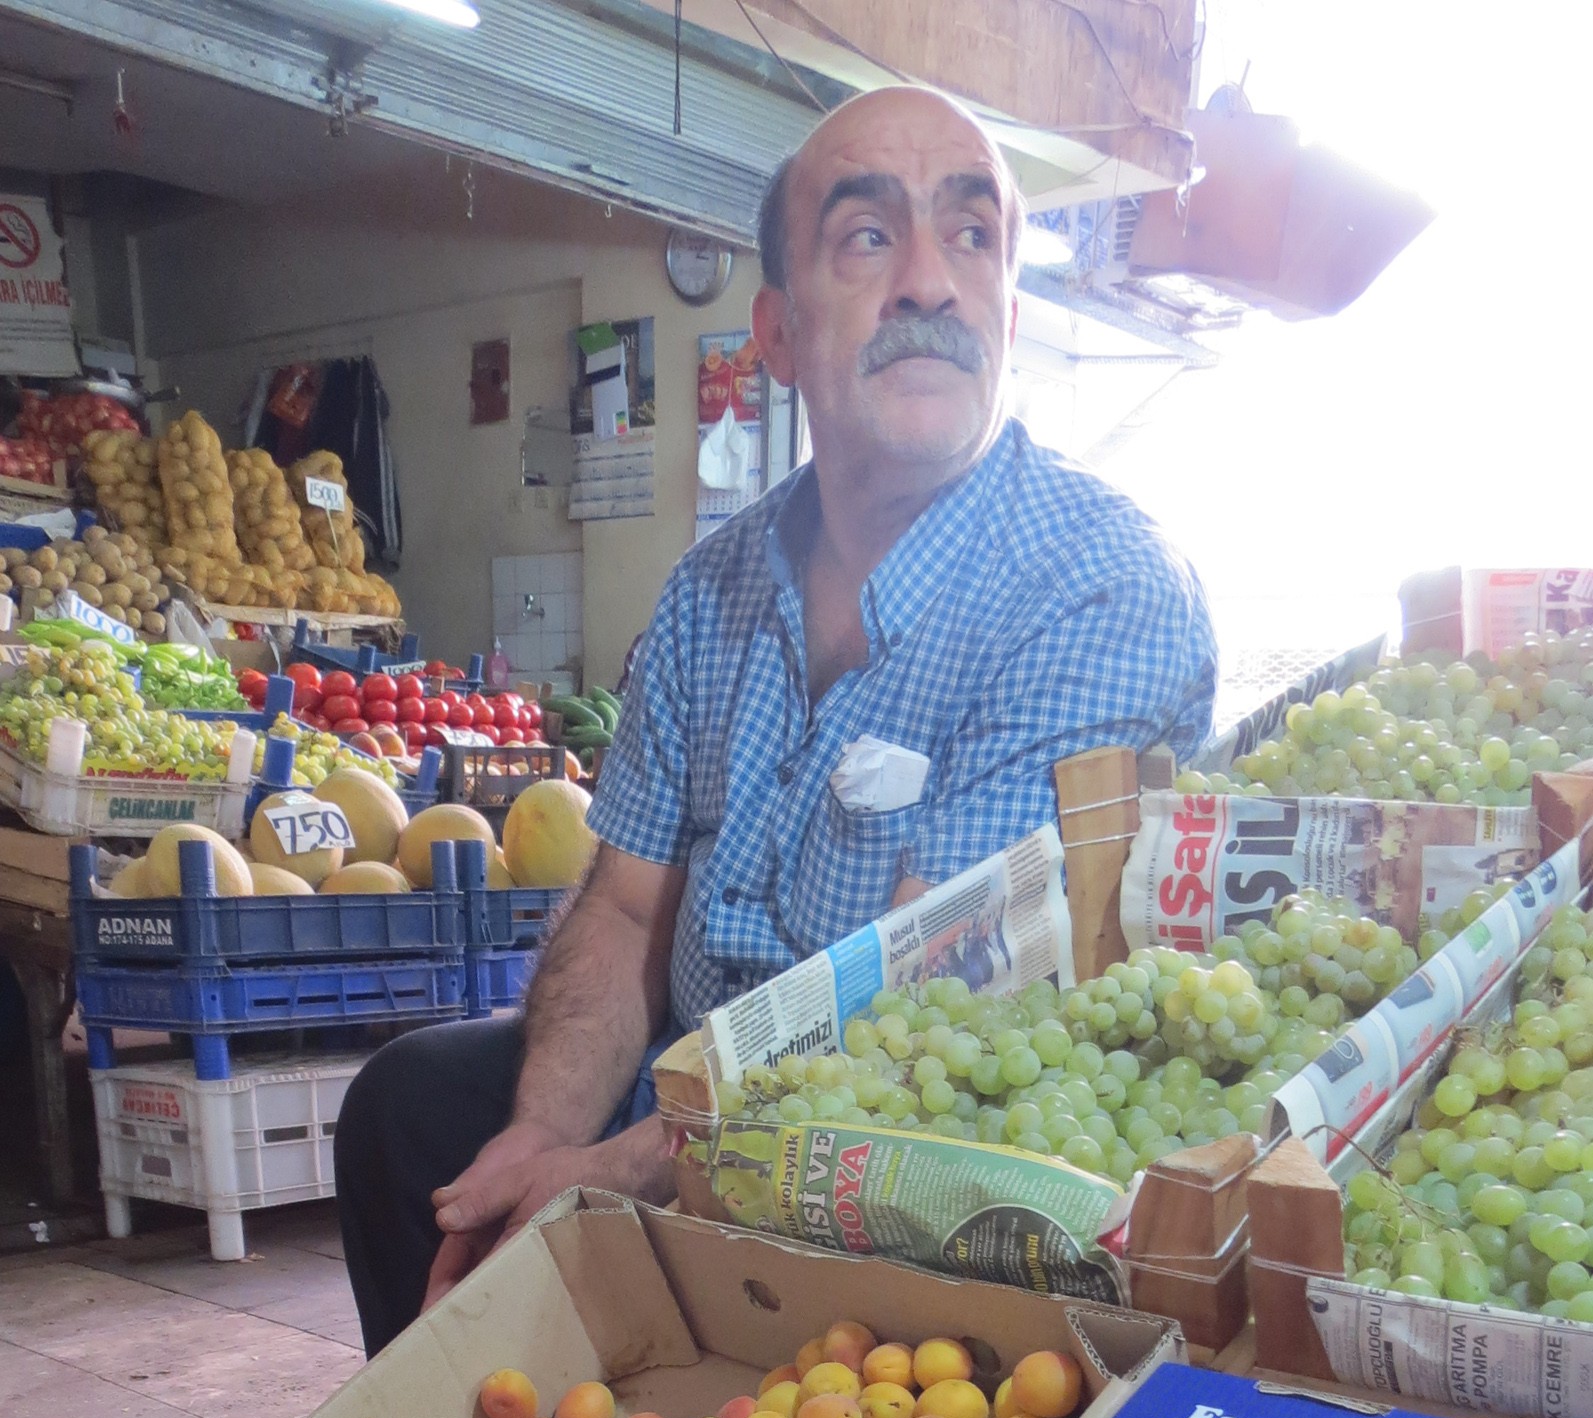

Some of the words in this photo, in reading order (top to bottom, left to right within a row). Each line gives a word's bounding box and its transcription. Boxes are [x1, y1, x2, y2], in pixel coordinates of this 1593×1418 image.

[97, 917, 173, 936] ADNAN
[889, 917, 916, 947] Musul
[889, 934, 921, 964] boşaldı
[779, 1133, 800, 1211] kolaylık
[805, 1130, 838, 1185] VE
[833, 1140, 876, 1255] BOYA
[1366, 1302, 1384, 1392] TOPÇUOĞLU
[1450, 1323, 1468, 1394] ARITMA
[1471, 1334, 1489, 1399] POMPA
[1546, 1335, 1563, 1405] CEMRE
